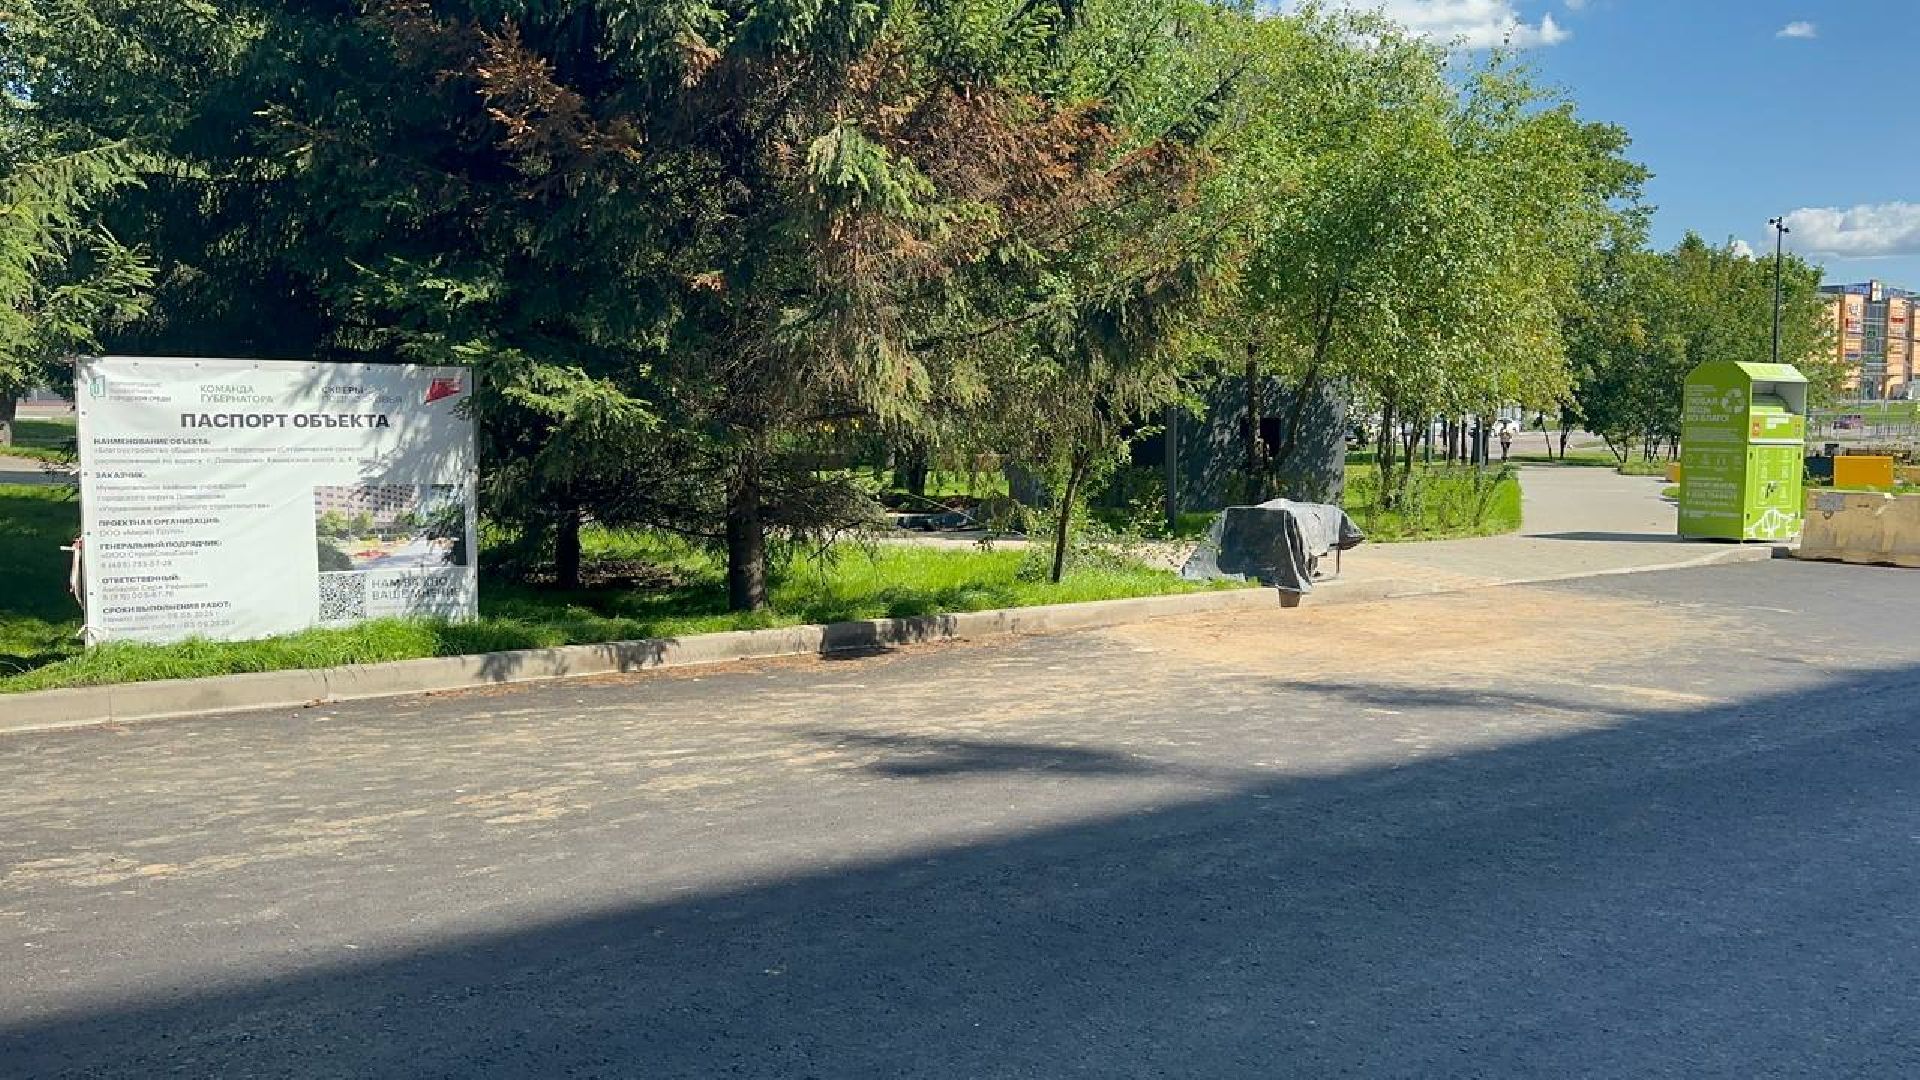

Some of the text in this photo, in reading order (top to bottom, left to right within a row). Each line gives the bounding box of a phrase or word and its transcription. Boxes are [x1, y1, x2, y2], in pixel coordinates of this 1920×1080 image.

[200, 385, 255, 394] КОМАНДА
[200, 395, 274, 404] ГУБЕРНАТОРА
[180, 413, 390, 428] ПАСПОРТ ОБЪЕКТА
[98, 518, 153, 527] ПРОЕКТНАЯ
[102, 606, 135, 614] СРОКИ
